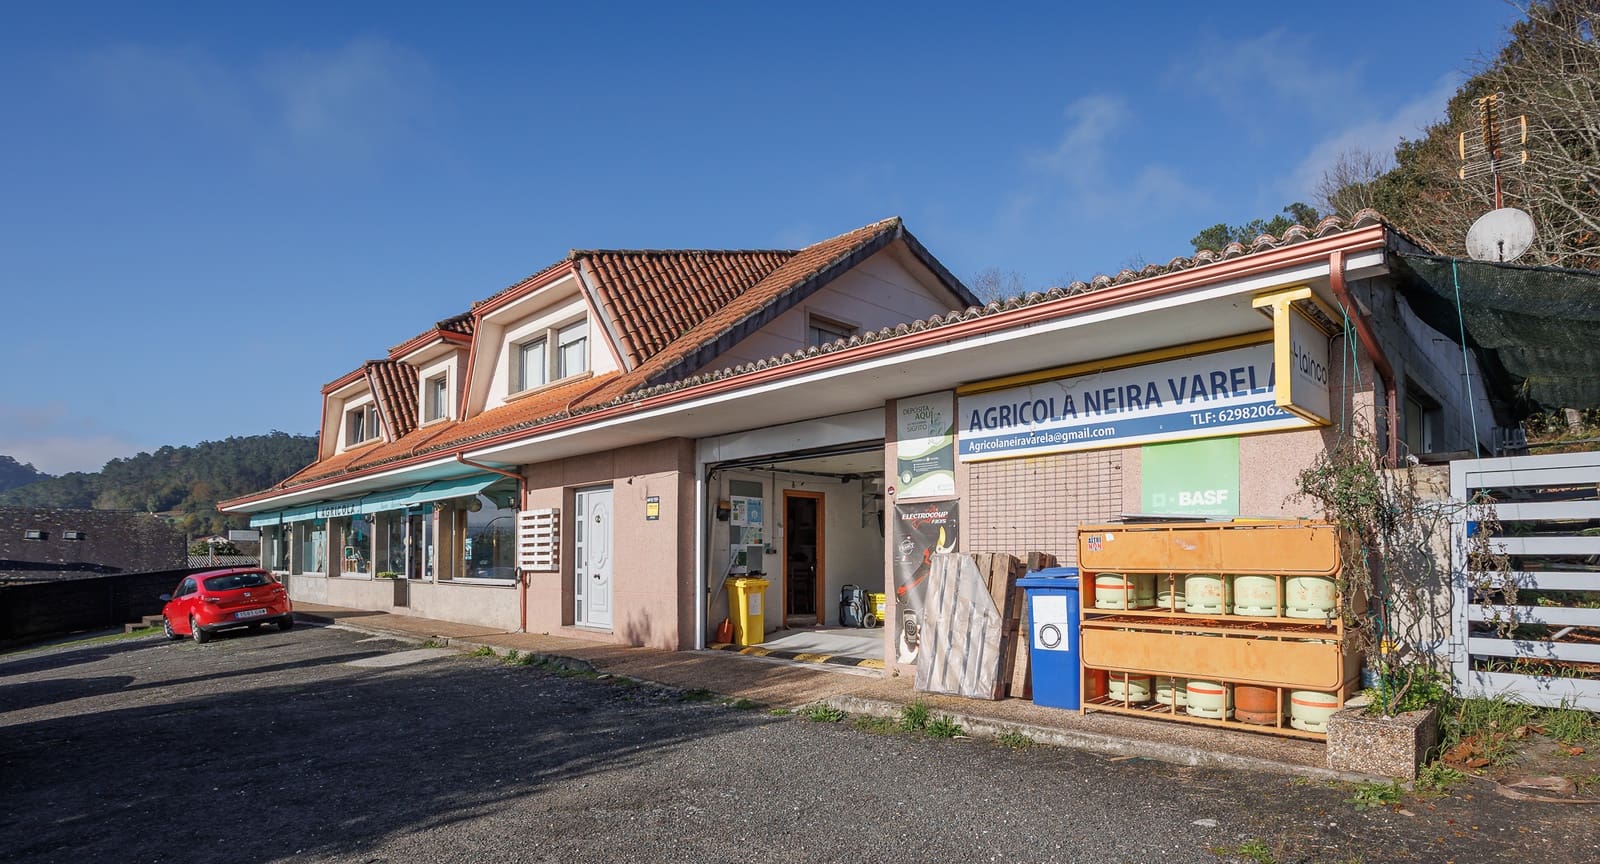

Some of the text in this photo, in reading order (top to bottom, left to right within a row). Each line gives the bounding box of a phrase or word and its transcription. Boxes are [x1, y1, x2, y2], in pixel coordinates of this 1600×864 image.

[969, 394, 1078, 433] AGRICOLA
[1084, 381, 1163, 417] NEIRA
[1190, 412, 1217, 426] TLF:
[968, 426, 1116, 453] Agricolaneiravarela@gmail.com
[1178, 489, 1229, 507] BASF
[320, 503, 355, 517] AGRICOLA
[902, 511, 949, 521] ELECTROCOUP
